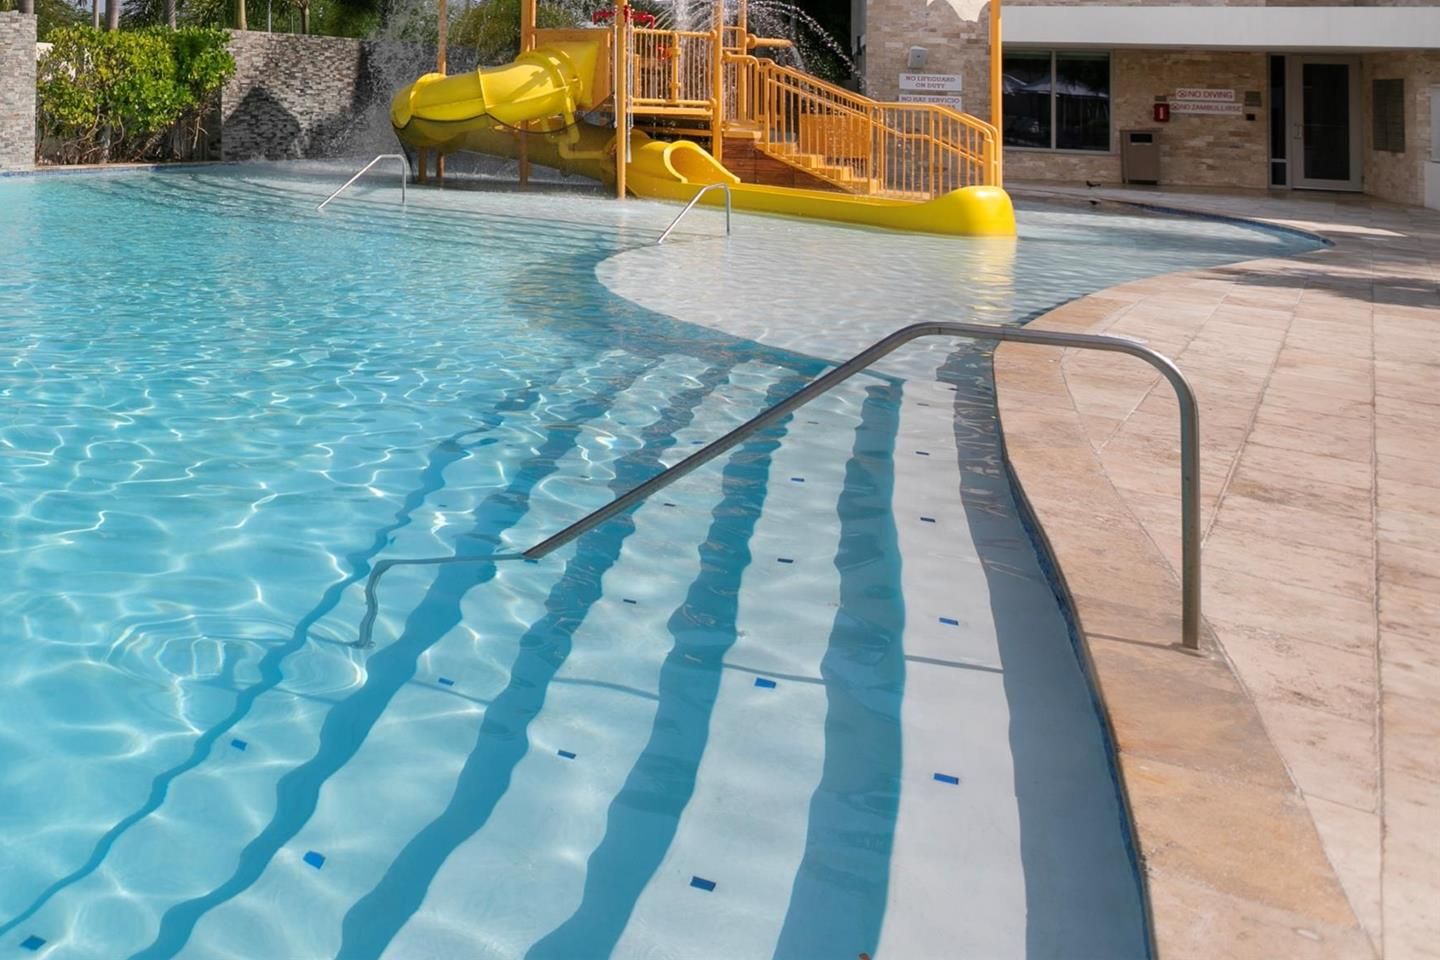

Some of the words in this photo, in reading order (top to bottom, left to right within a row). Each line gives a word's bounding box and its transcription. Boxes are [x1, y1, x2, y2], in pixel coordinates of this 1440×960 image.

[1187, 90, 1202, 98] NO
[1203, 90, 1233, 99] DIVING
[1192, 104, 1241, 112] ZAMBULLIRSE
